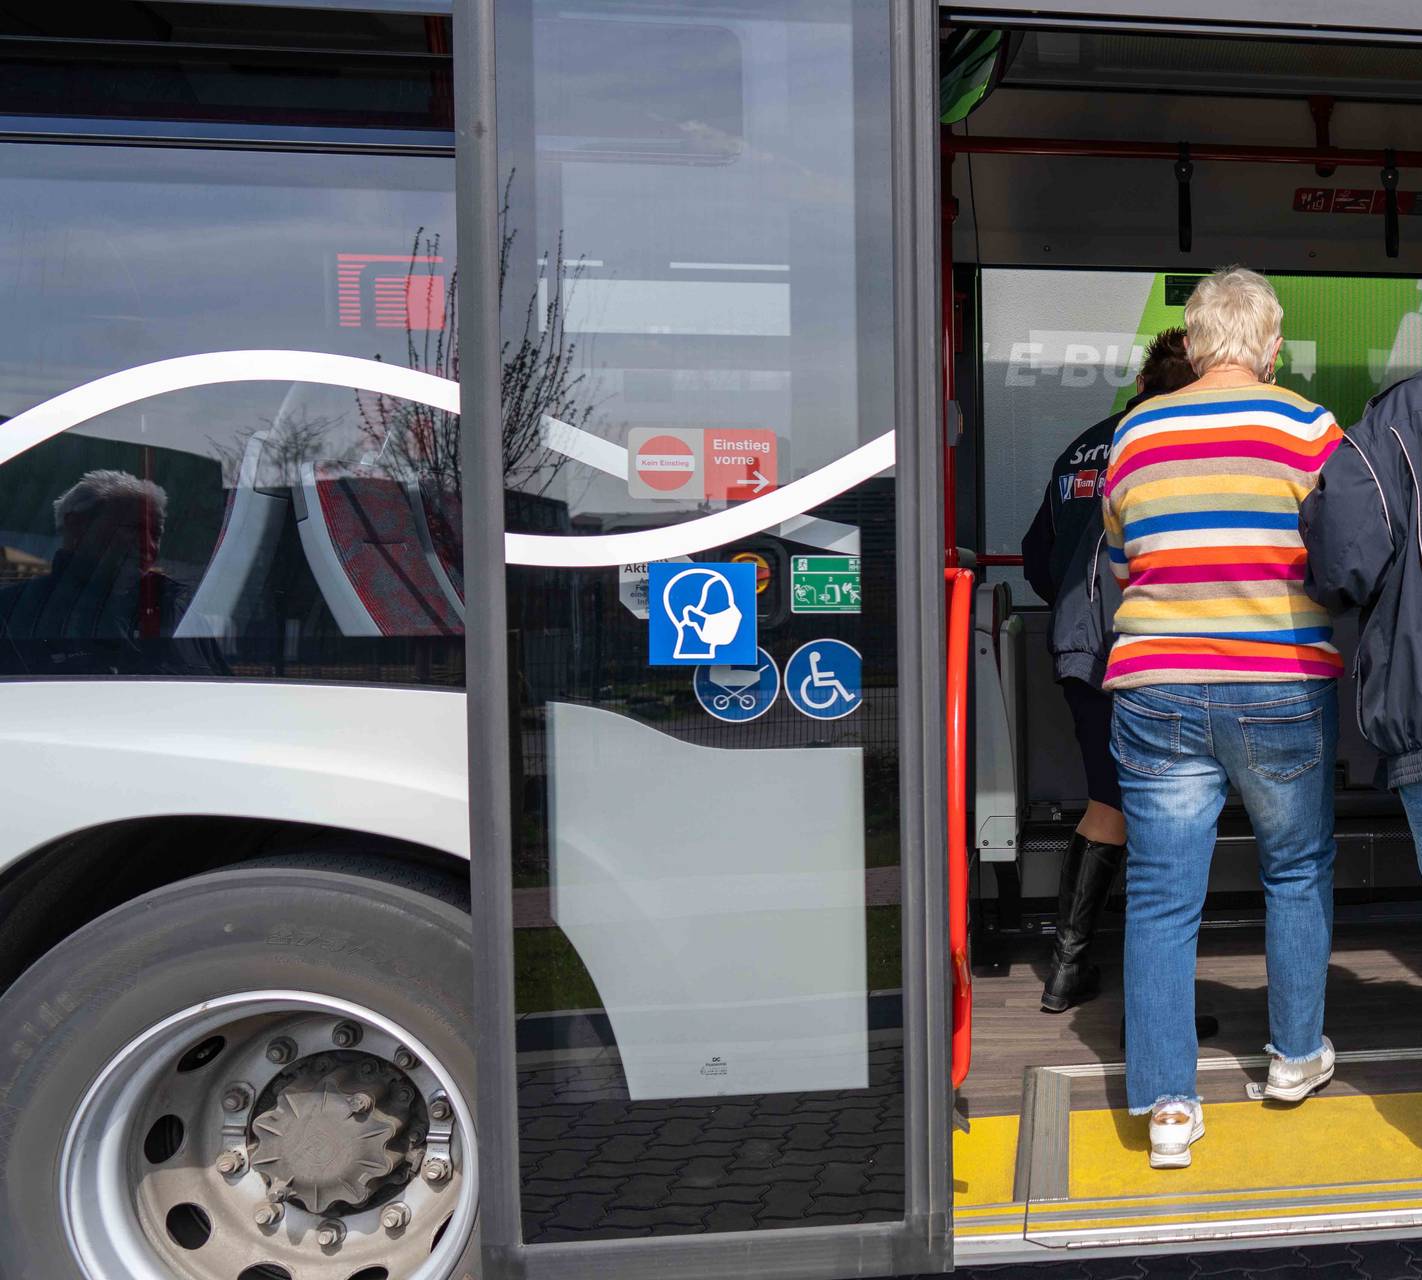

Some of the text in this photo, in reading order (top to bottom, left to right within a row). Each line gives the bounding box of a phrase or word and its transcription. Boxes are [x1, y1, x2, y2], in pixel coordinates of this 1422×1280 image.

[1005, 342, 1144, 388] E-BU
[713, 439, 770, 454] Einstieg
[660, 460, 689, 468] Einstieg
[714, 456, 754, 465] vorne
[1075, 479, 1093, 488] Tam
